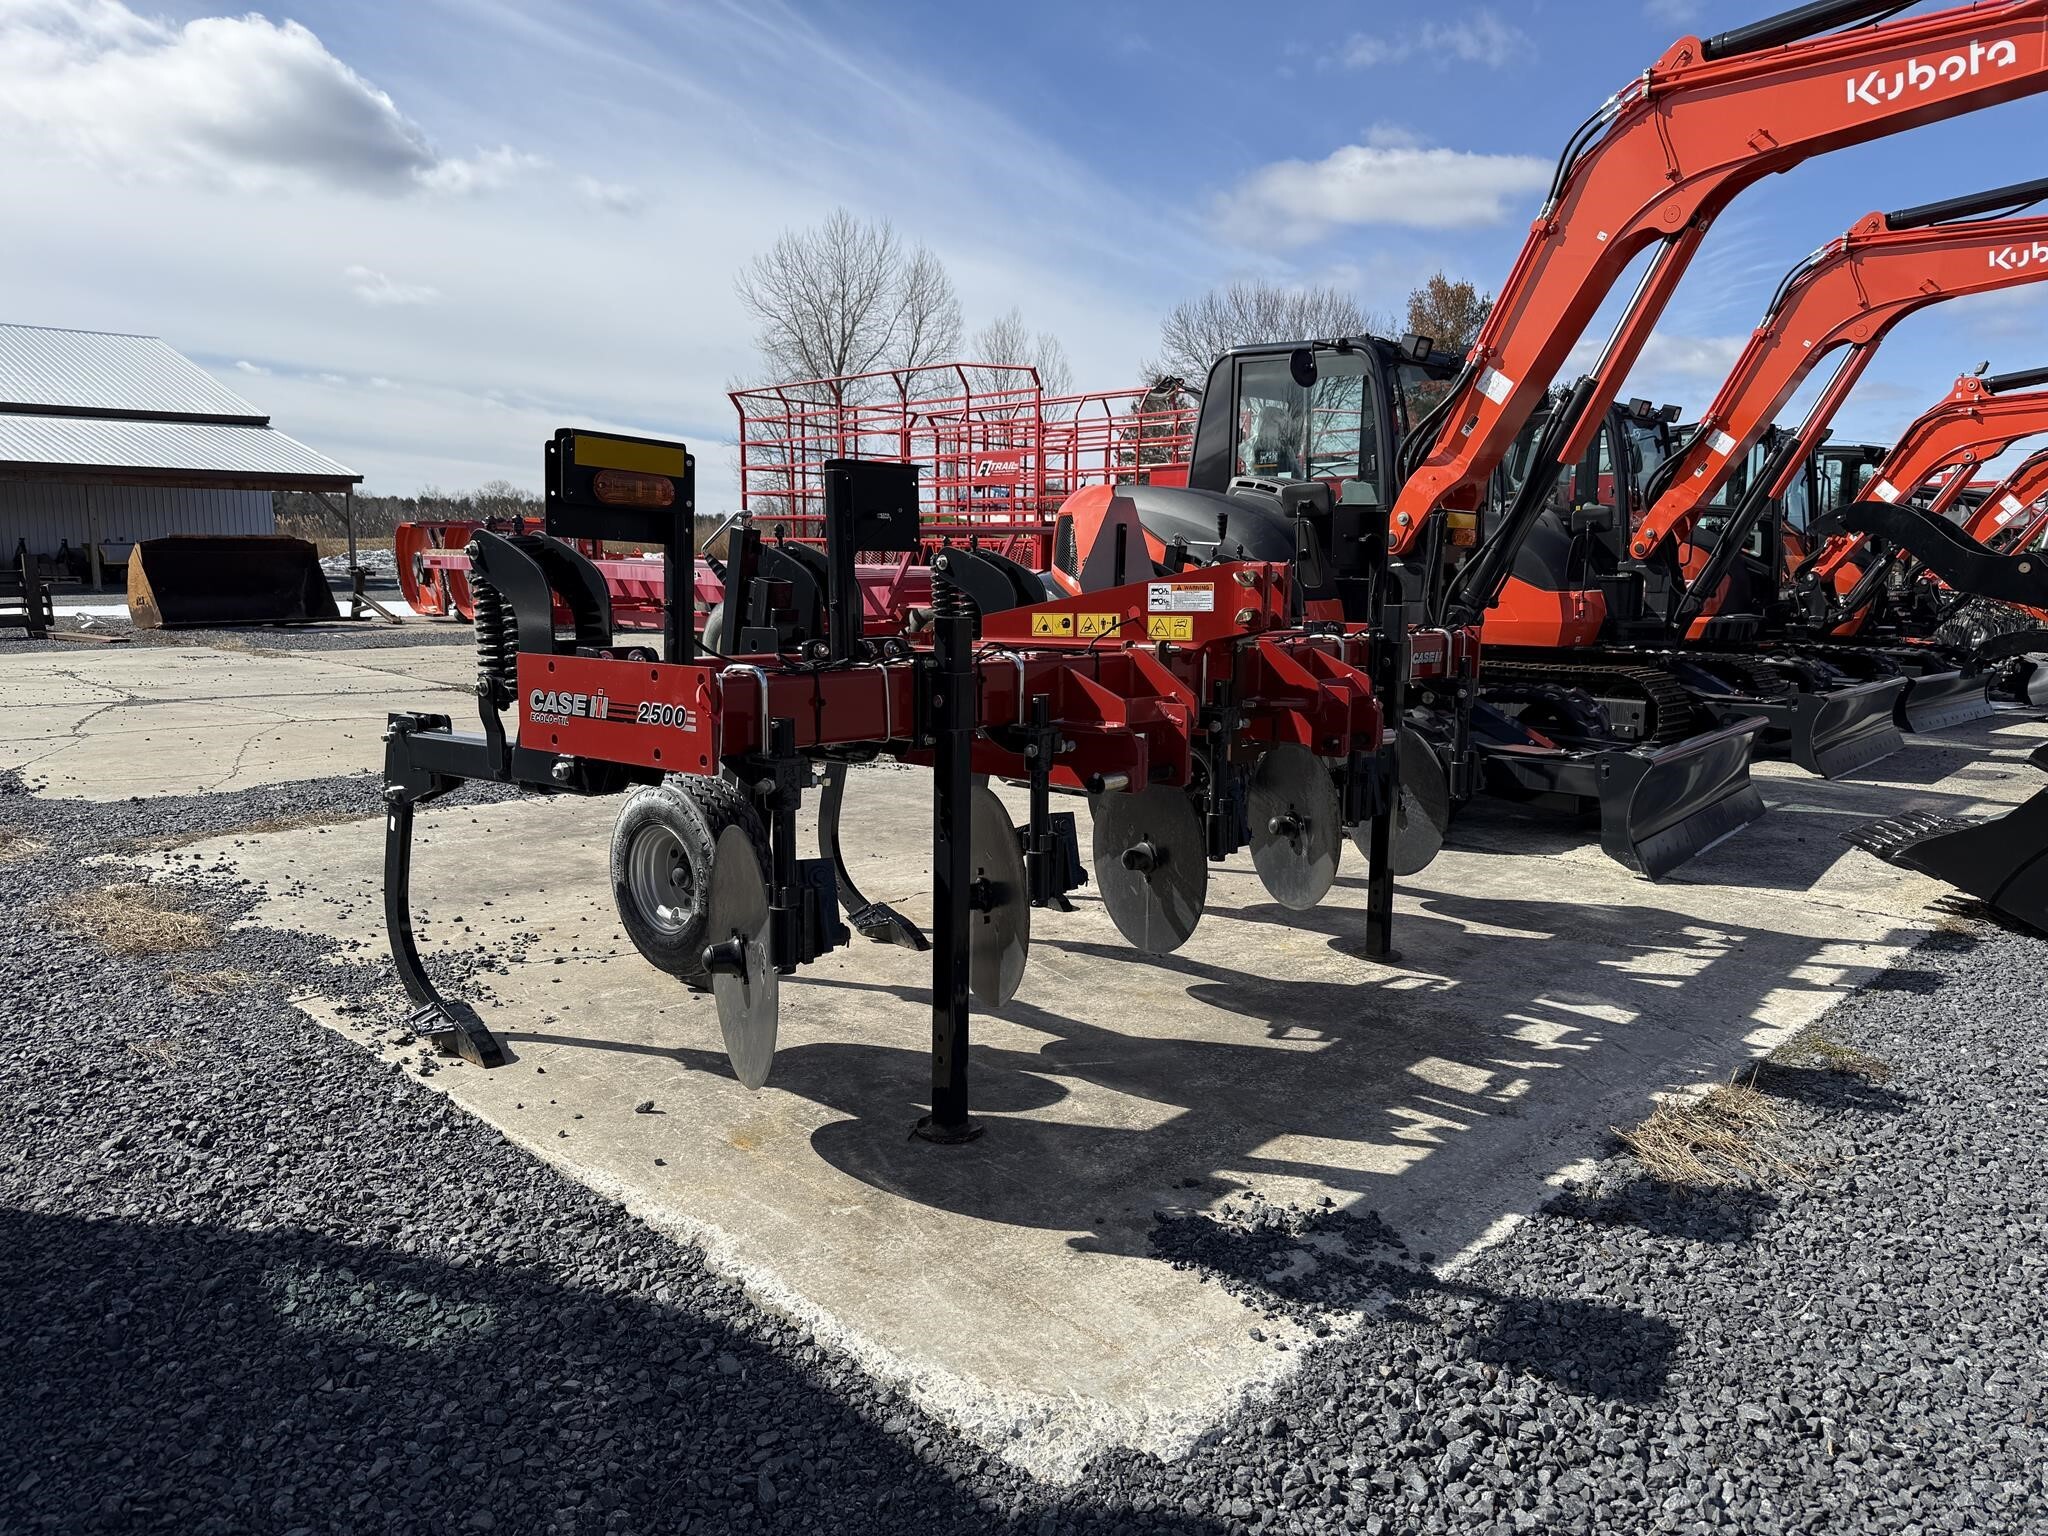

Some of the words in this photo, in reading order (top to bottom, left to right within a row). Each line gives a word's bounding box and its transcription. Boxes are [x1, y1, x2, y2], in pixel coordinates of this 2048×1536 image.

[1846, 39, 2017, 106] Kubota
[1184, 584, 1209, 592] WARNING
[529, 689, 587, 716] CASE
[637, 701, 687, 729] 2500
[529, 711, 569, 727] ECOLO-TIL
